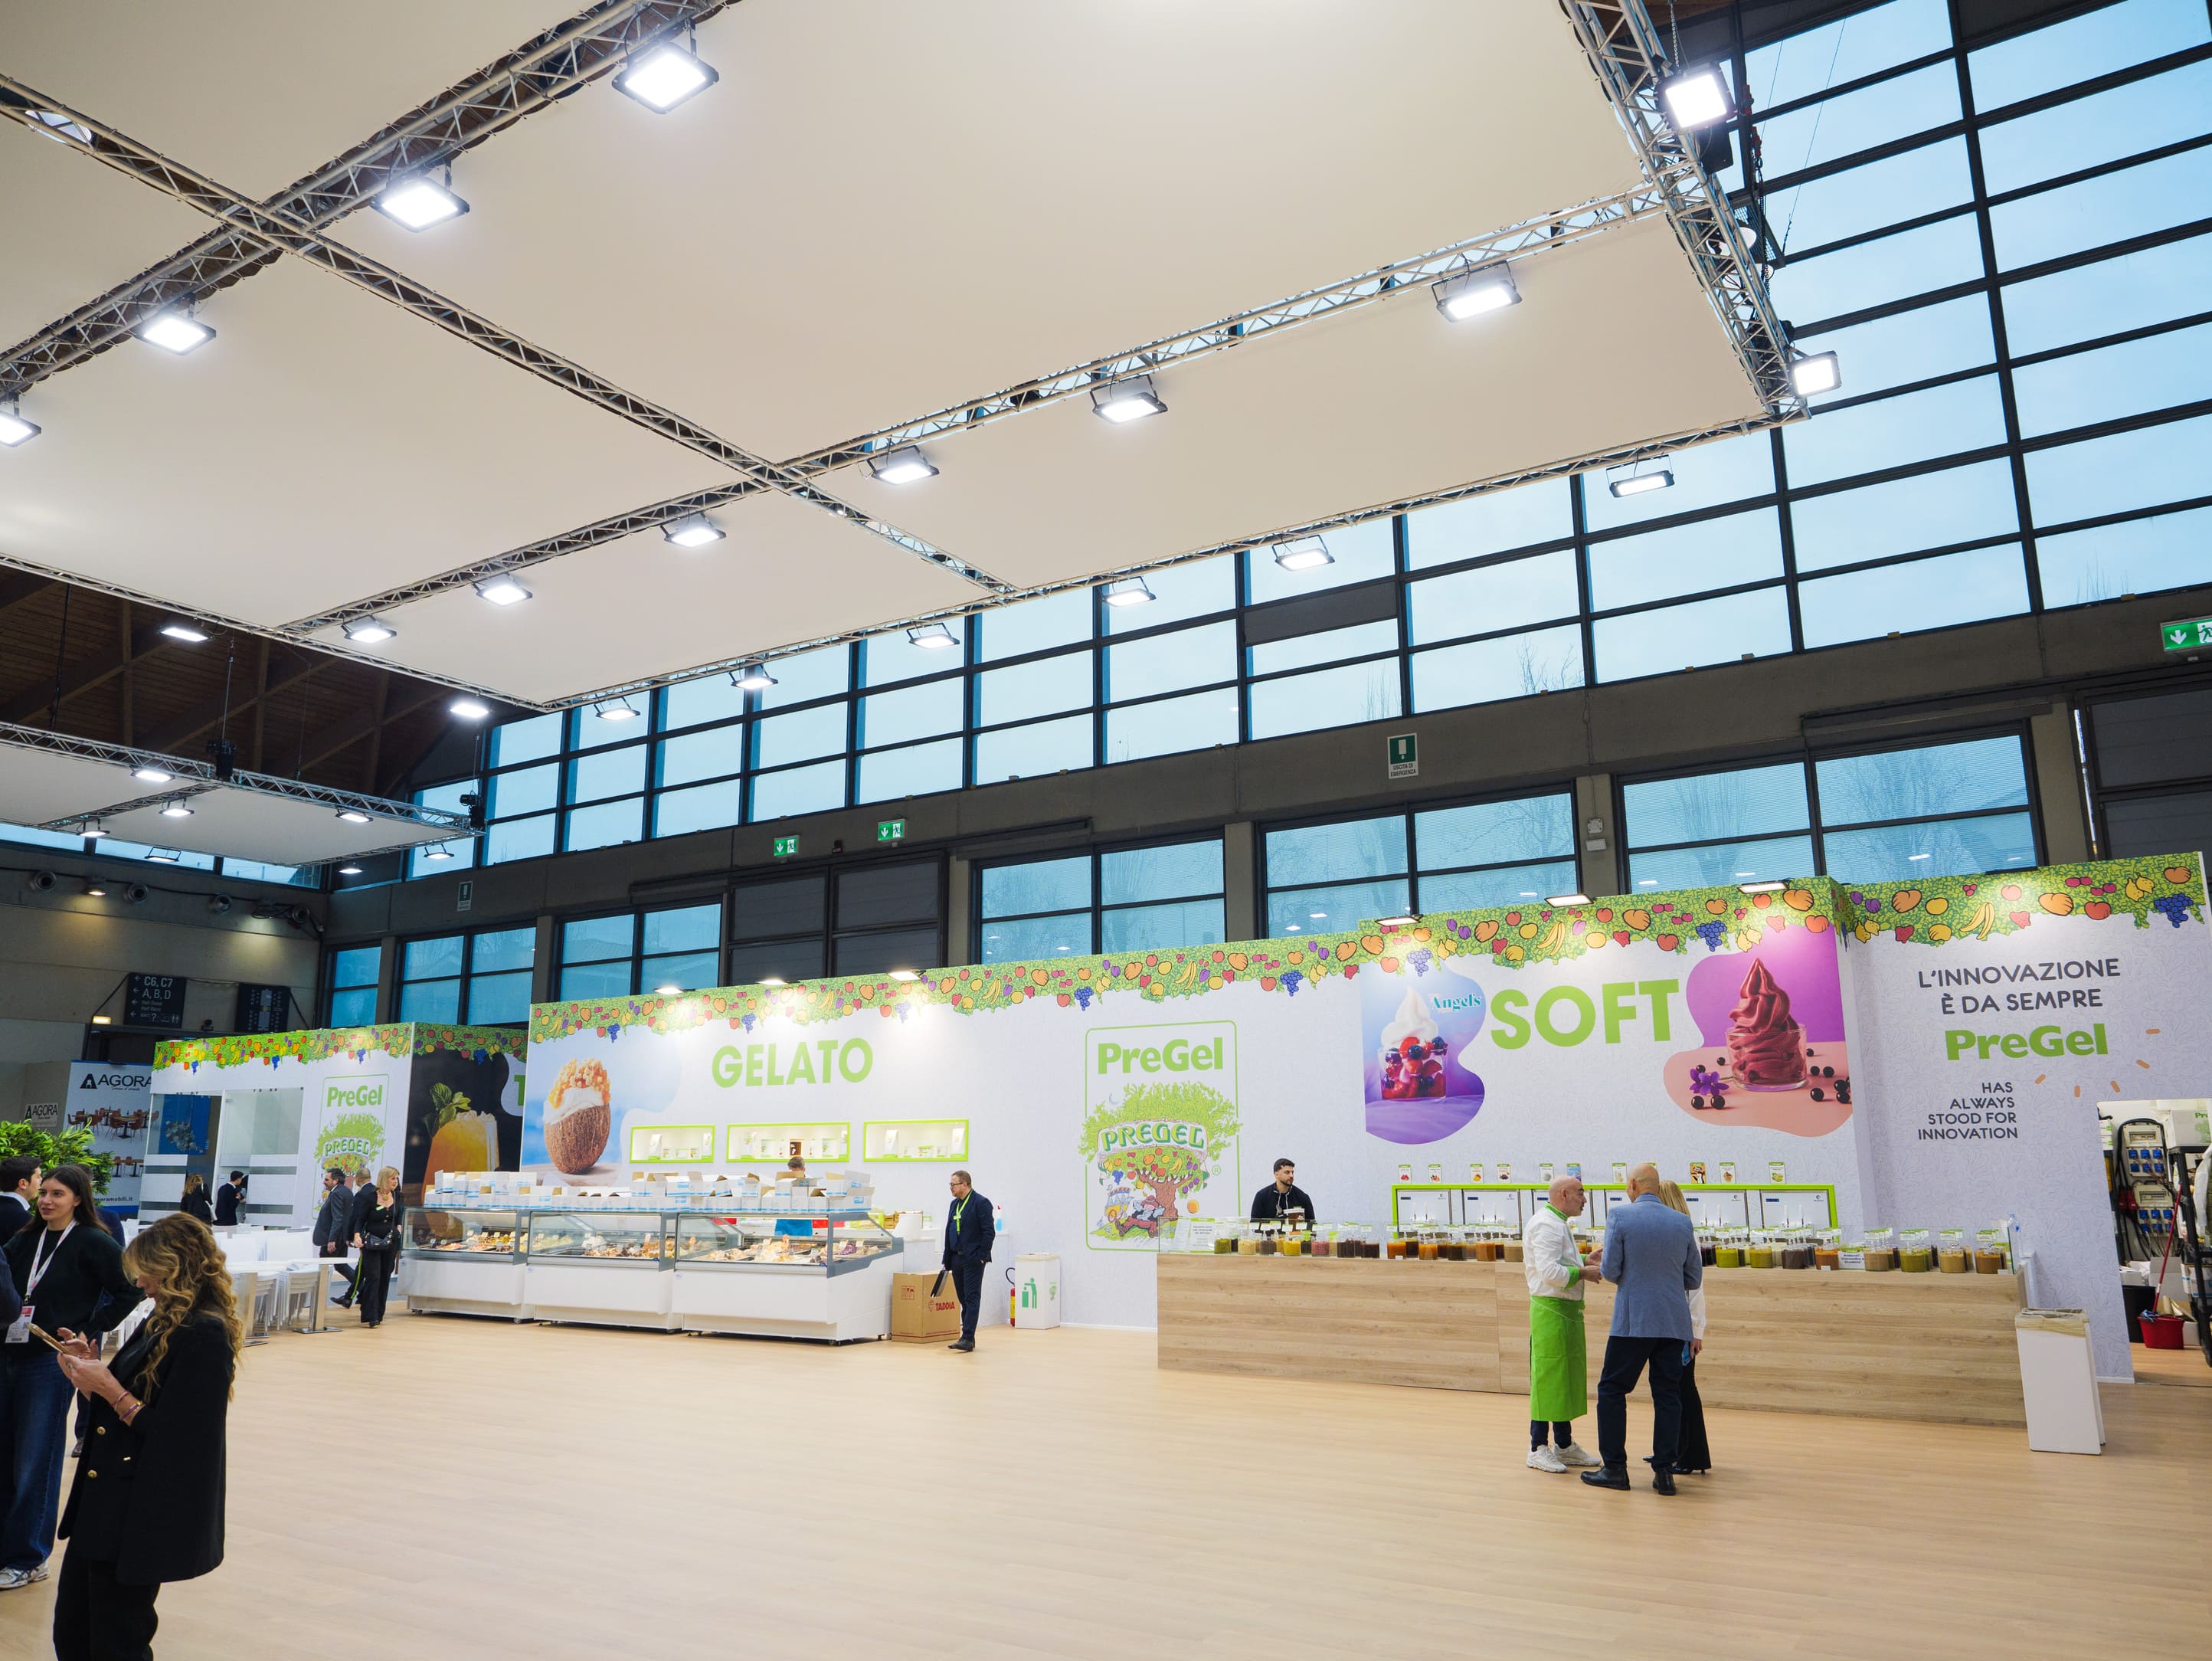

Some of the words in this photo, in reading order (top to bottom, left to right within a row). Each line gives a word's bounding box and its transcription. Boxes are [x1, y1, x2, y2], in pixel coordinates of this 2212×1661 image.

[160, 977, 173, 988] C7
[165, 990, 171, 999] D
[1941, 993, 1955, 1014] È
[1962, 995, 2000, 1013] DA
[2007, 988, 2103, 1011] SEMPRE
[1490, 979, 1680, 1050] SOFT
[1945, 1024, 2109, 1060] PreGel
[712, 1037, 873, 1087] GELATO
[1098, 1037, 1222, 1073] PreGel
[327, 1085, 382, 1107] PreGel
[1981, 1081, 2013, 1094] HAS
[1949, 1096, 2015, 1110] ALWAYS
[1928, 1113, 1981, 1125] STOOD
[1986, 1112, 2017, 1124] FOR
[1101, 1122, 1204, 1152] PREGEL
[1919, 1128, 2018, 1141] INNOVATION
[324, 1138, 370, 1157] PREGEL
[935, 1301, 955, 1312] TADDIA
